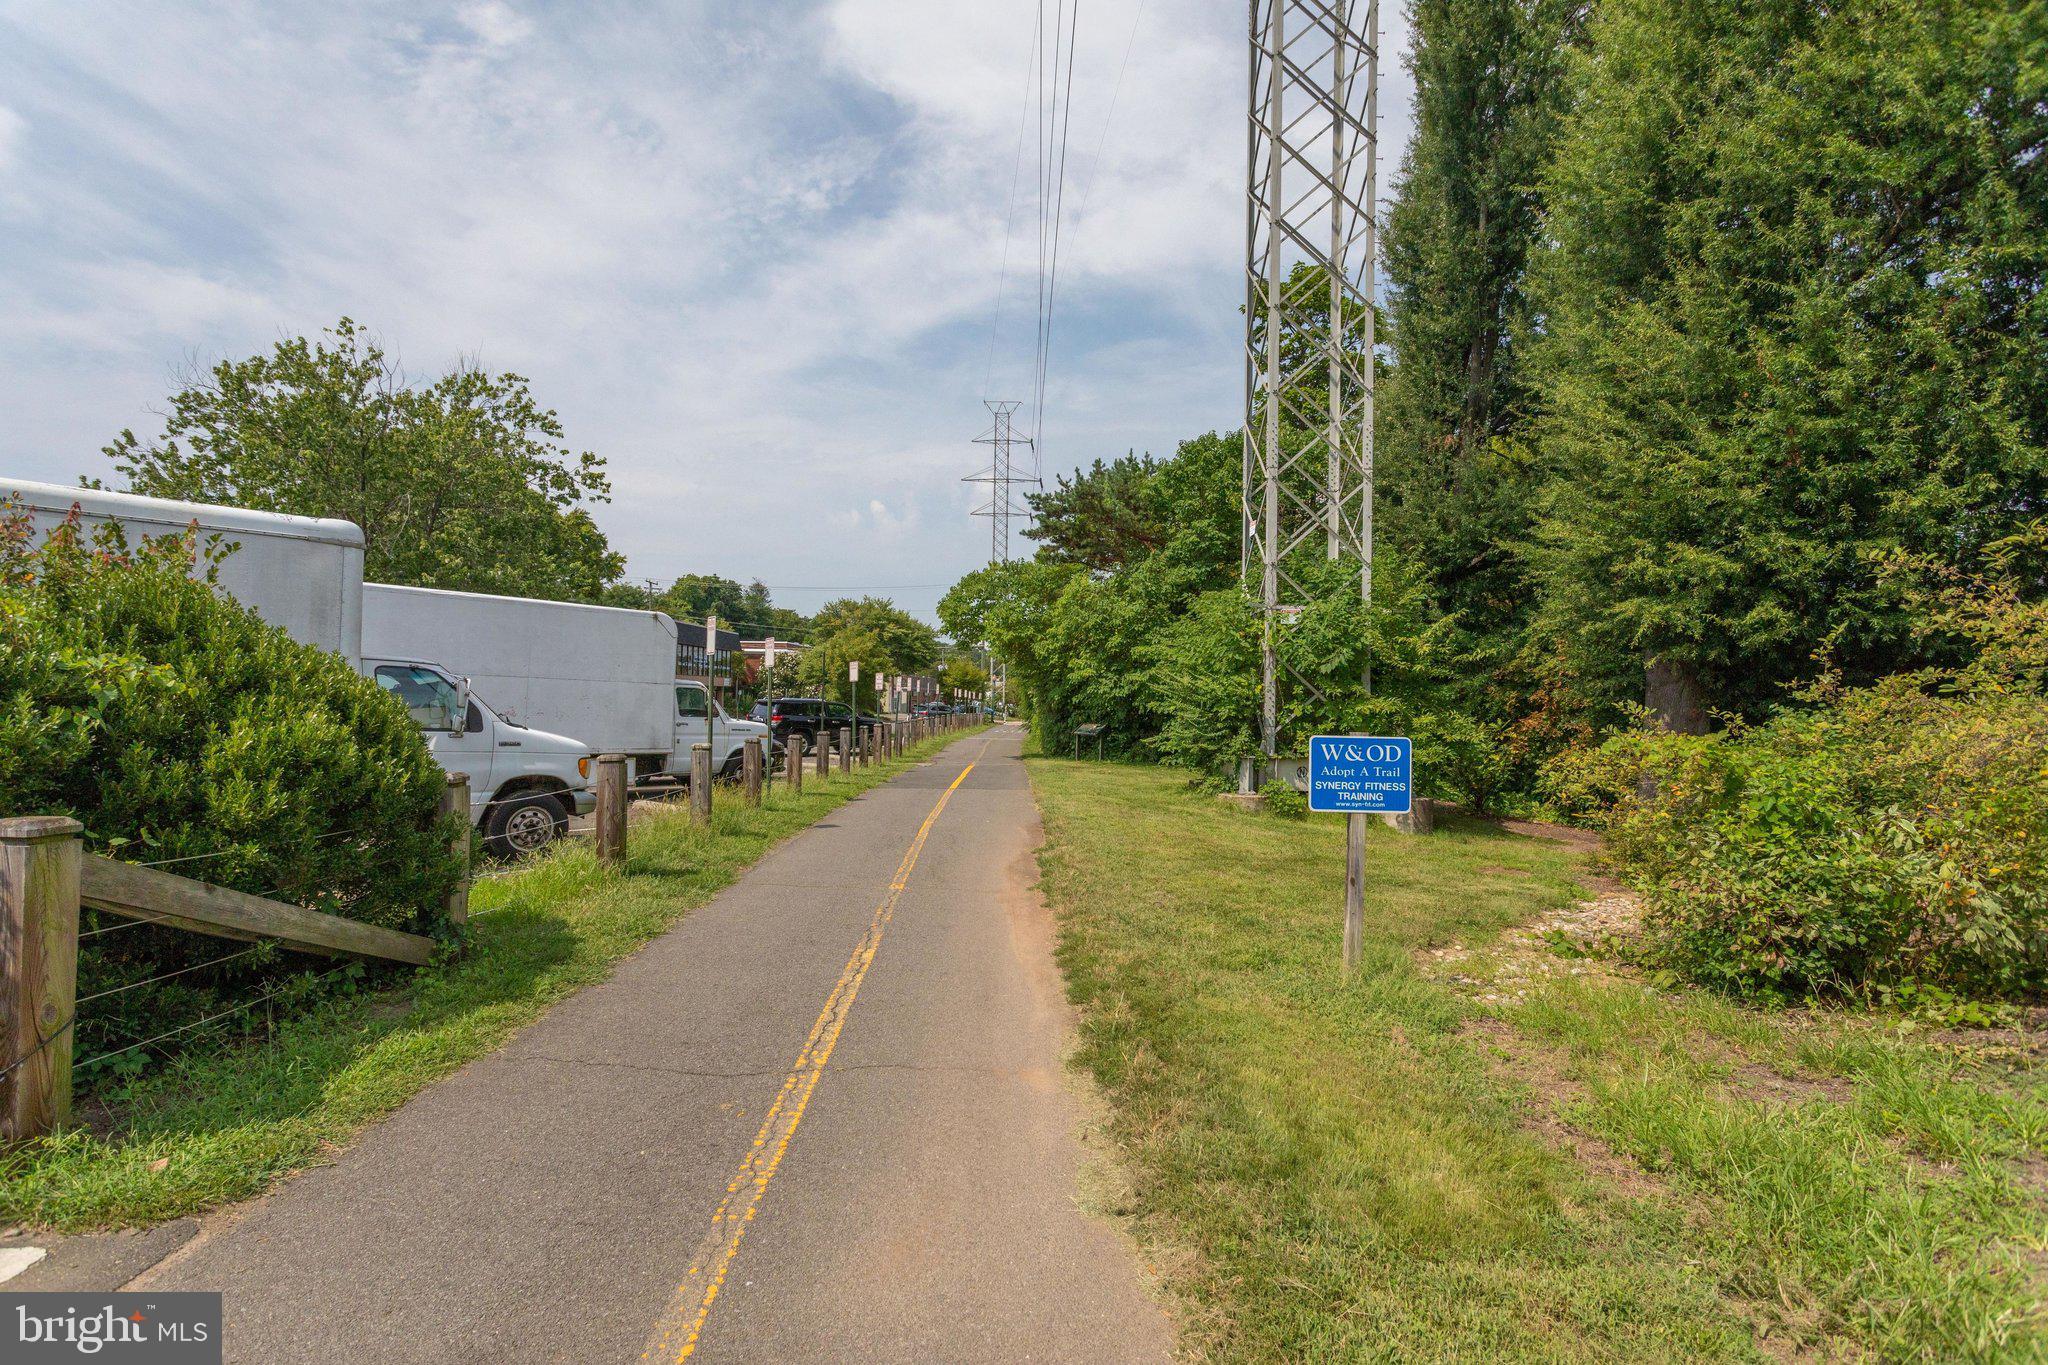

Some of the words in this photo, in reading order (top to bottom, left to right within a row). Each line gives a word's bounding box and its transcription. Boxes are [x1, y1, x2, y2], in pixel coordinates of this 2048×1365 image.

[1321, 743, 1402, 762] W&OD
[1321, 766, 1355, 778] Adopt
[1360, 767, 1369, 776] A
[1373, 766, 1400, 777] Trail
[1315, 781, 1361, 790] SYNERGY
[1365, 782, 1406, 791] FITNESS
[1338, 792, 1384, 801] TRAINING
